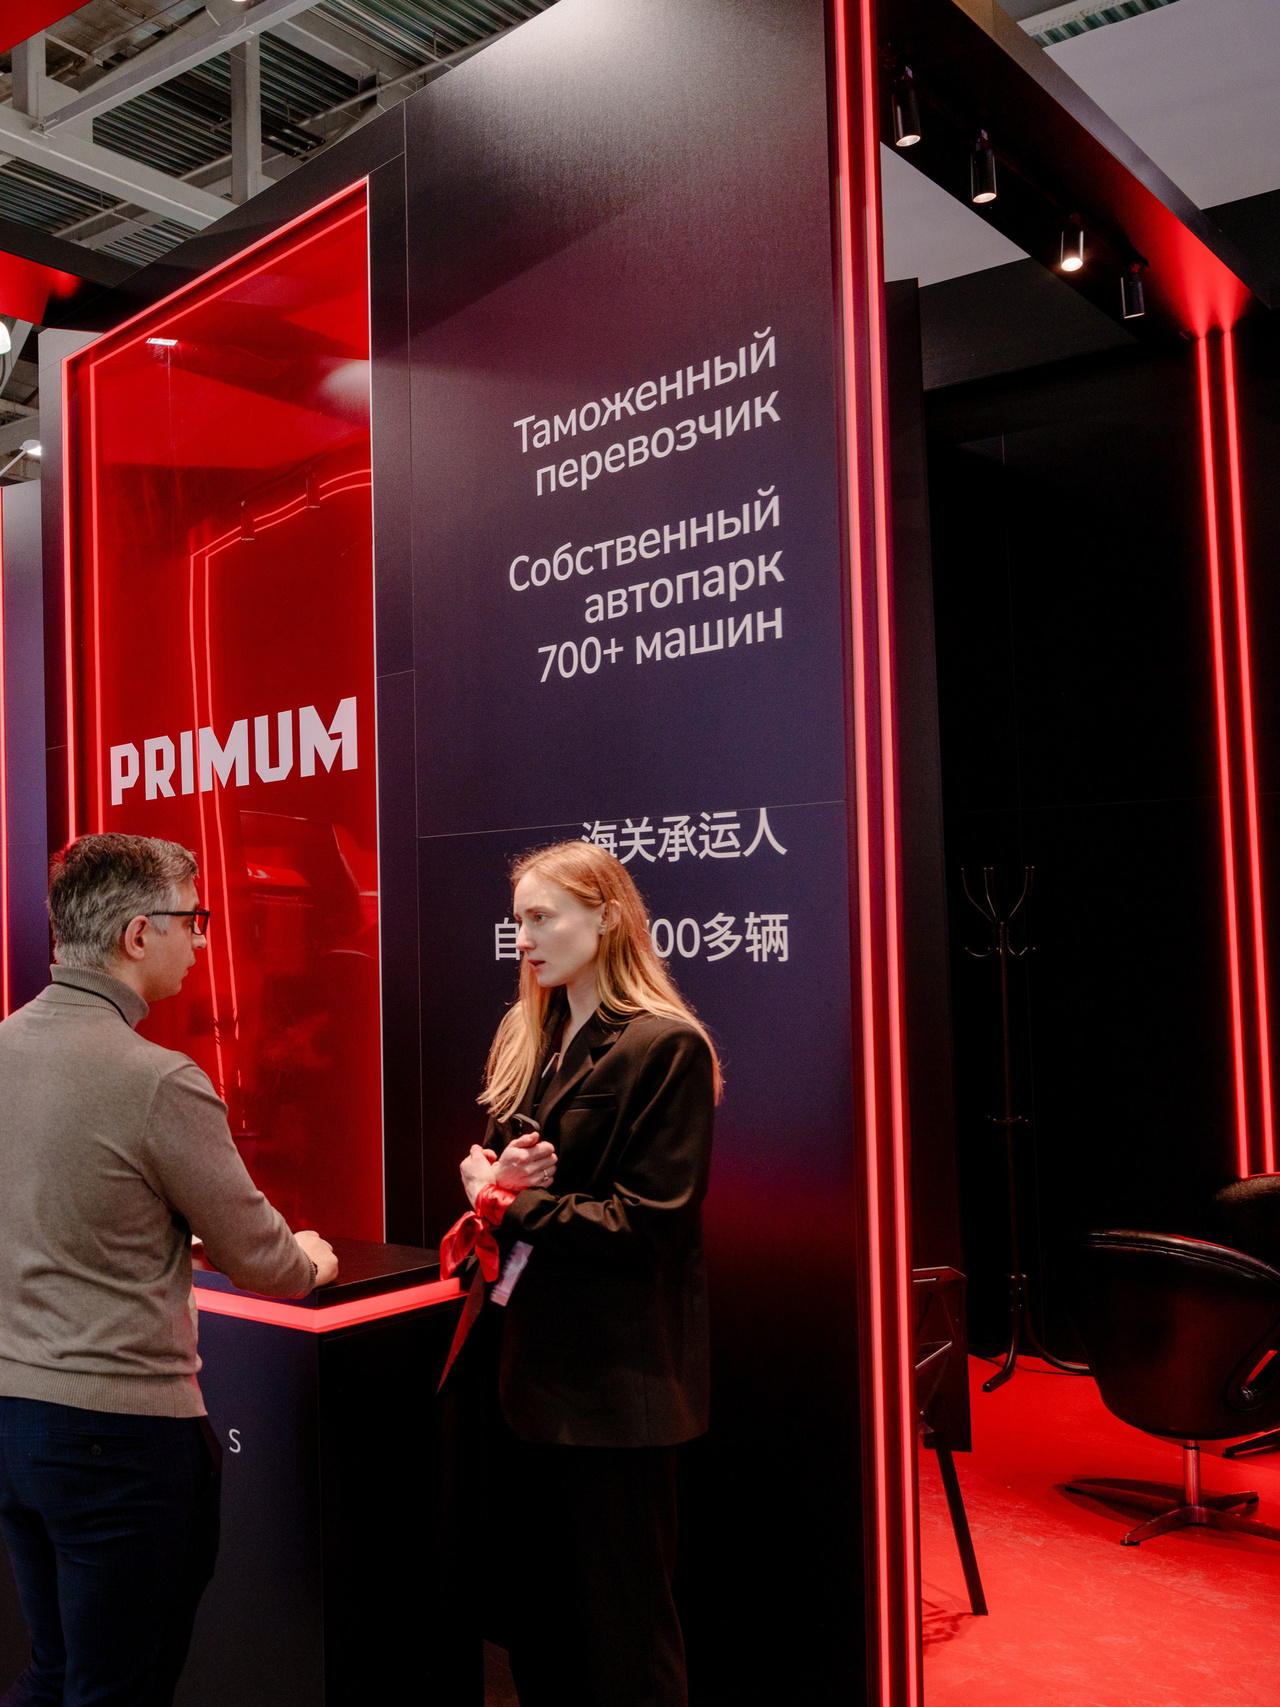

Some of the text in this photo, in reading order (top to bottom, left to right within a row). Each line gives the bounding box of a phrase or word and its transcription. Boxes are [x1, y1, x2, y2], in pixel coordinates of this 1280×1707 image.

[513, 326, 777, 453] Таможенный
[536, 390, 781, 496] перевозчик
[509, 485, 780, 591] Собственный
[584, 550, 785, 624] автопарк
[537, 607, 783, 683] 700+ машин
[110, 696, 358, 806] PRIMUM
[581, 807, 788, 865] 海关承运人
